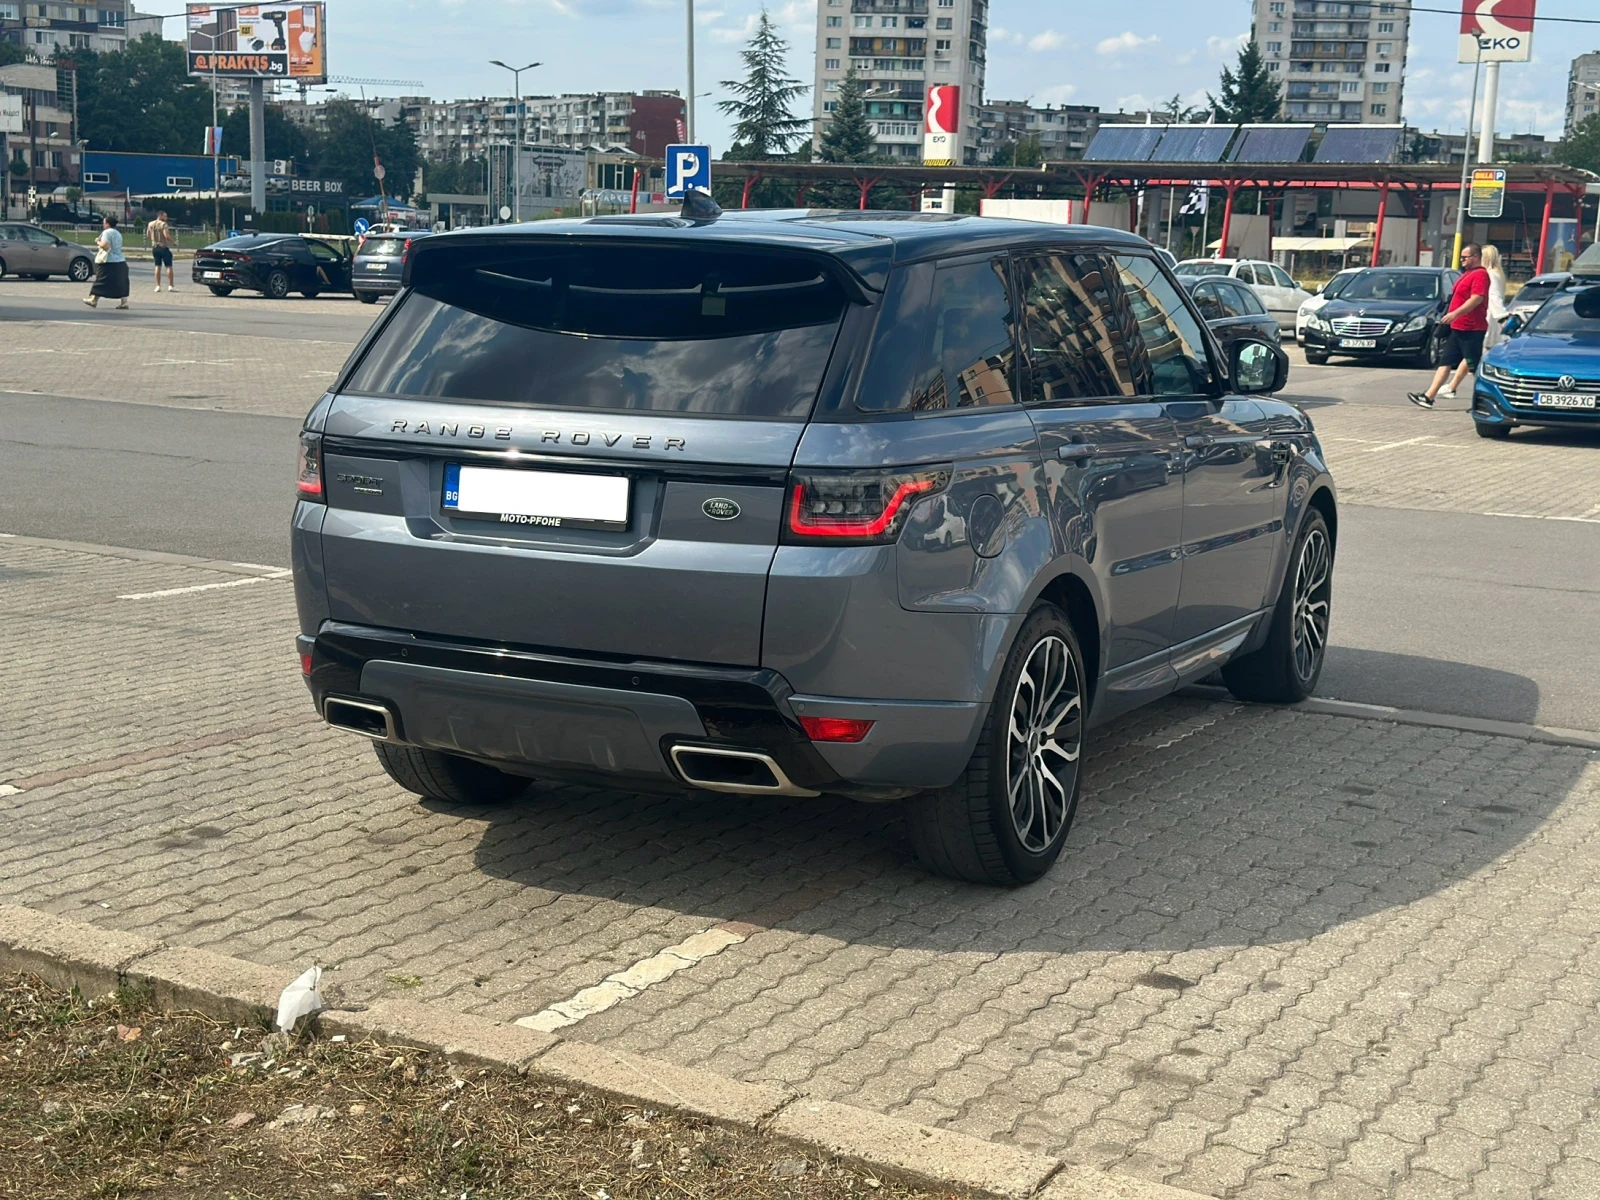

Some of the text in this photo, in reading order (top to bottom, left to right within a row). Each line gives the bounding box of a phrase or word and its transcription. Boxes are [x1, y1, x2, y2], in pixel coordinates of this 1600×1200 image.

[1479, 37, 1520, 50] EKO
[291, 180, 343, 193] BEER BOX
[1540, 394, 1594, 407] CB 3926 XC
[390, 419, 686, 451] RANGE ROVER
[446, 491, 458, 501] BG
[710, 500, 728, 510] LAND
[711, 508, 734, 516] ROVER
[500, 513, 561, 527] MOTO-PFOHE
